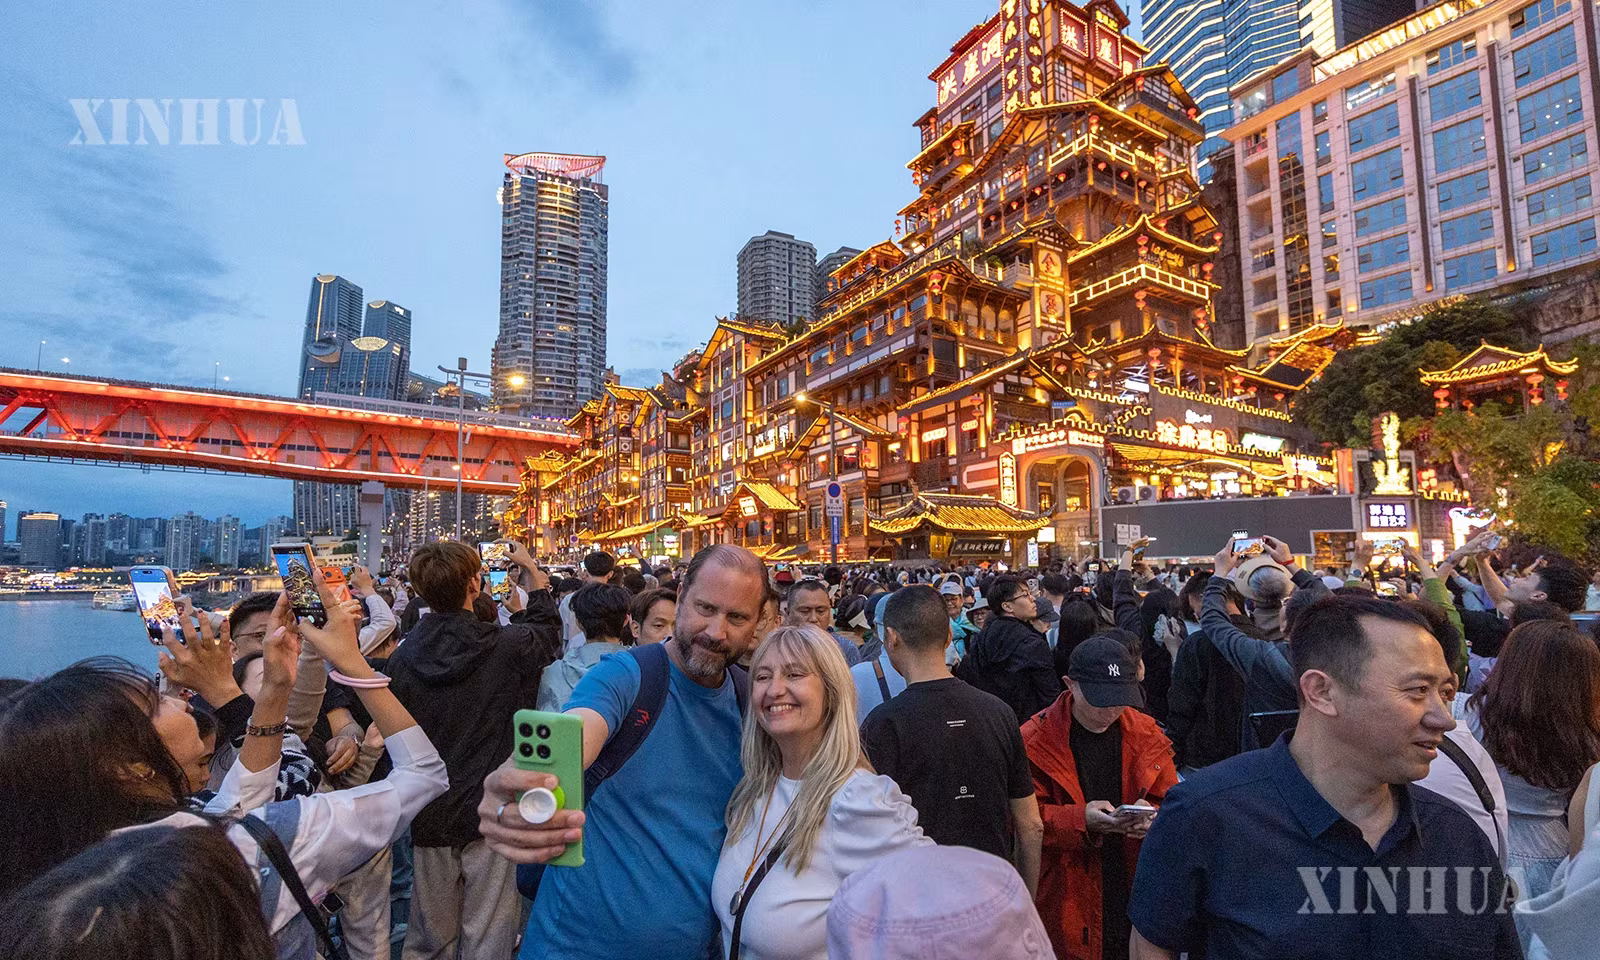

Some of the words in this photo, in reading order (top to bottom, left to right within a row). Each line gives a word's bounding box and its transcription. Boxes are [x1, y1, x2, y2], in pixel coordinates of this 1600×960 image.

[940, 31, 1000, 104] 洪崖洞
[1107, 663, 1121, 677] NY
